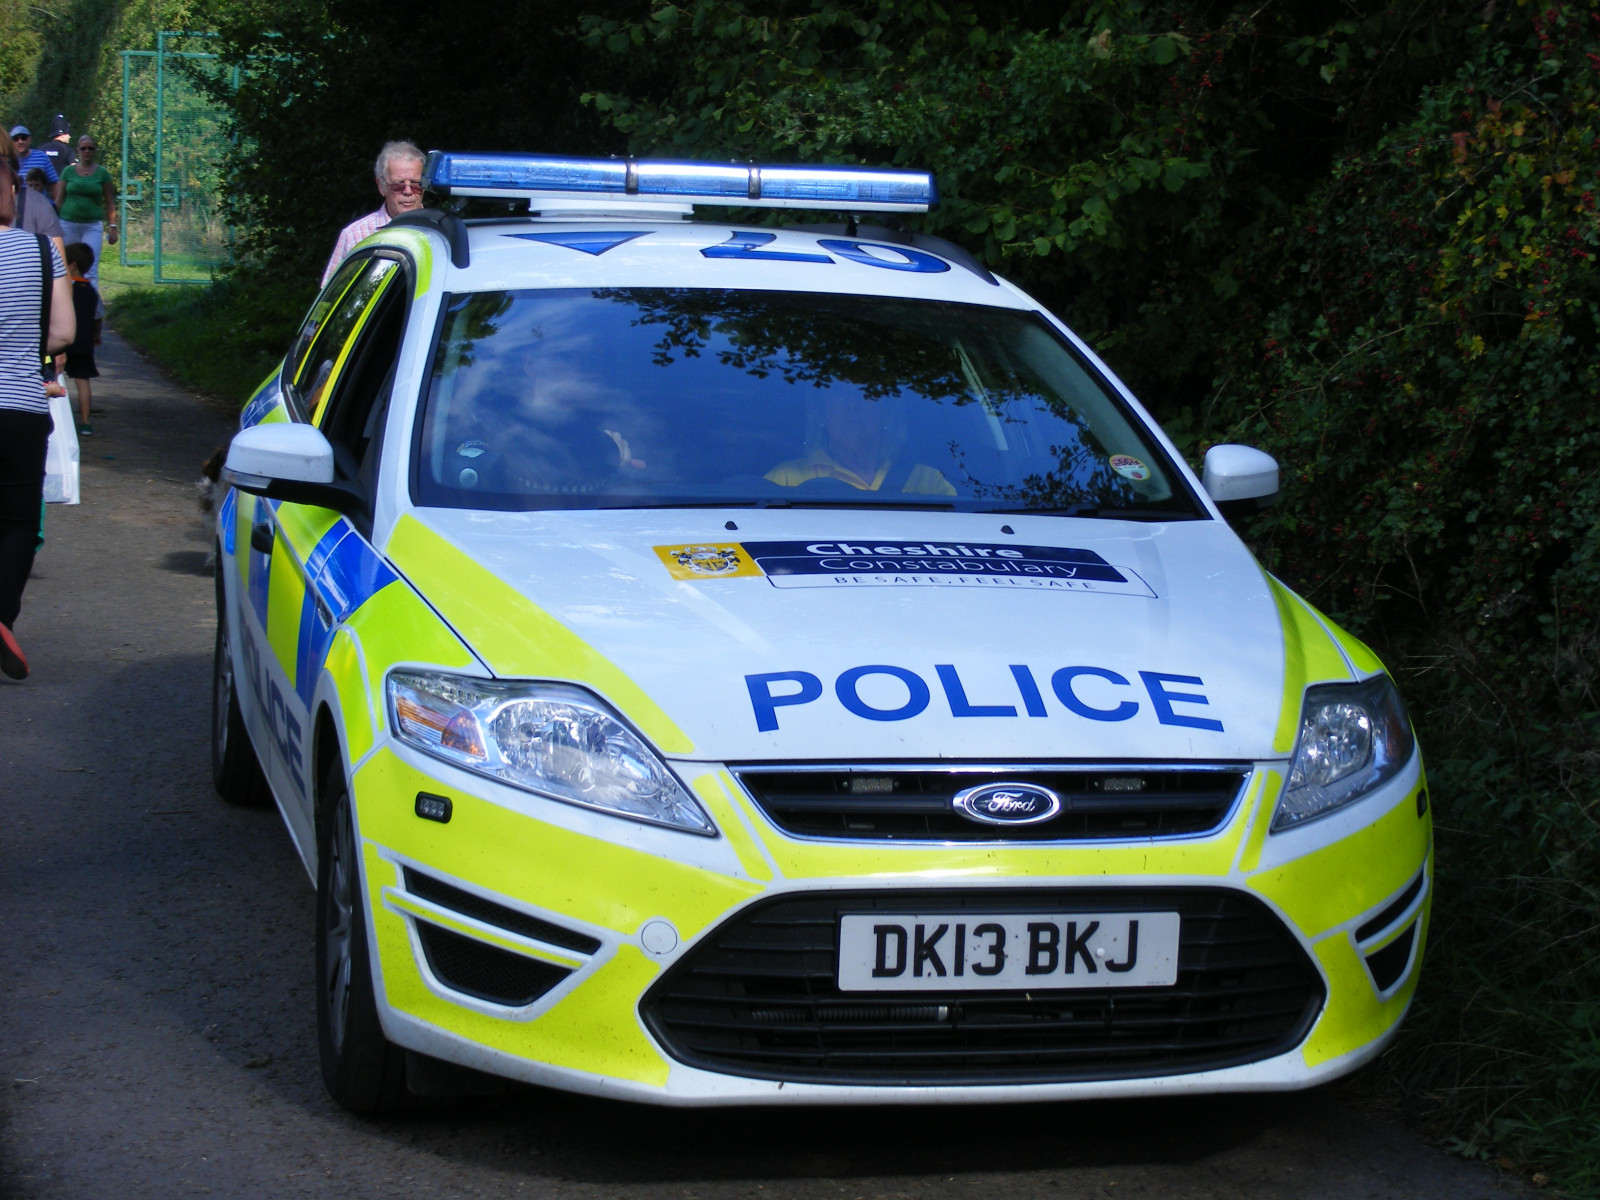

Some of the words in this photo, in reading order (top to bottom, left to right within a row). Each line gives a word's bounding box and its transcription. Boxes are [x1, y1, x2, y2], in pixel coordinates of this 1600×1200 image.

[806, 543, 1025, 558] Cheshire
[819, 558, 1078, 577] Constabulary
[834, 576, 865, 584] BE
[1030, 579, 1096, 590] SAFE
[745, 664, 1225, 733] POLICE
[985, 791, 1036, 812] Ford
[872, 922, 1006, 979] DK13
[1025, 920, 1140, 976] BKJ
